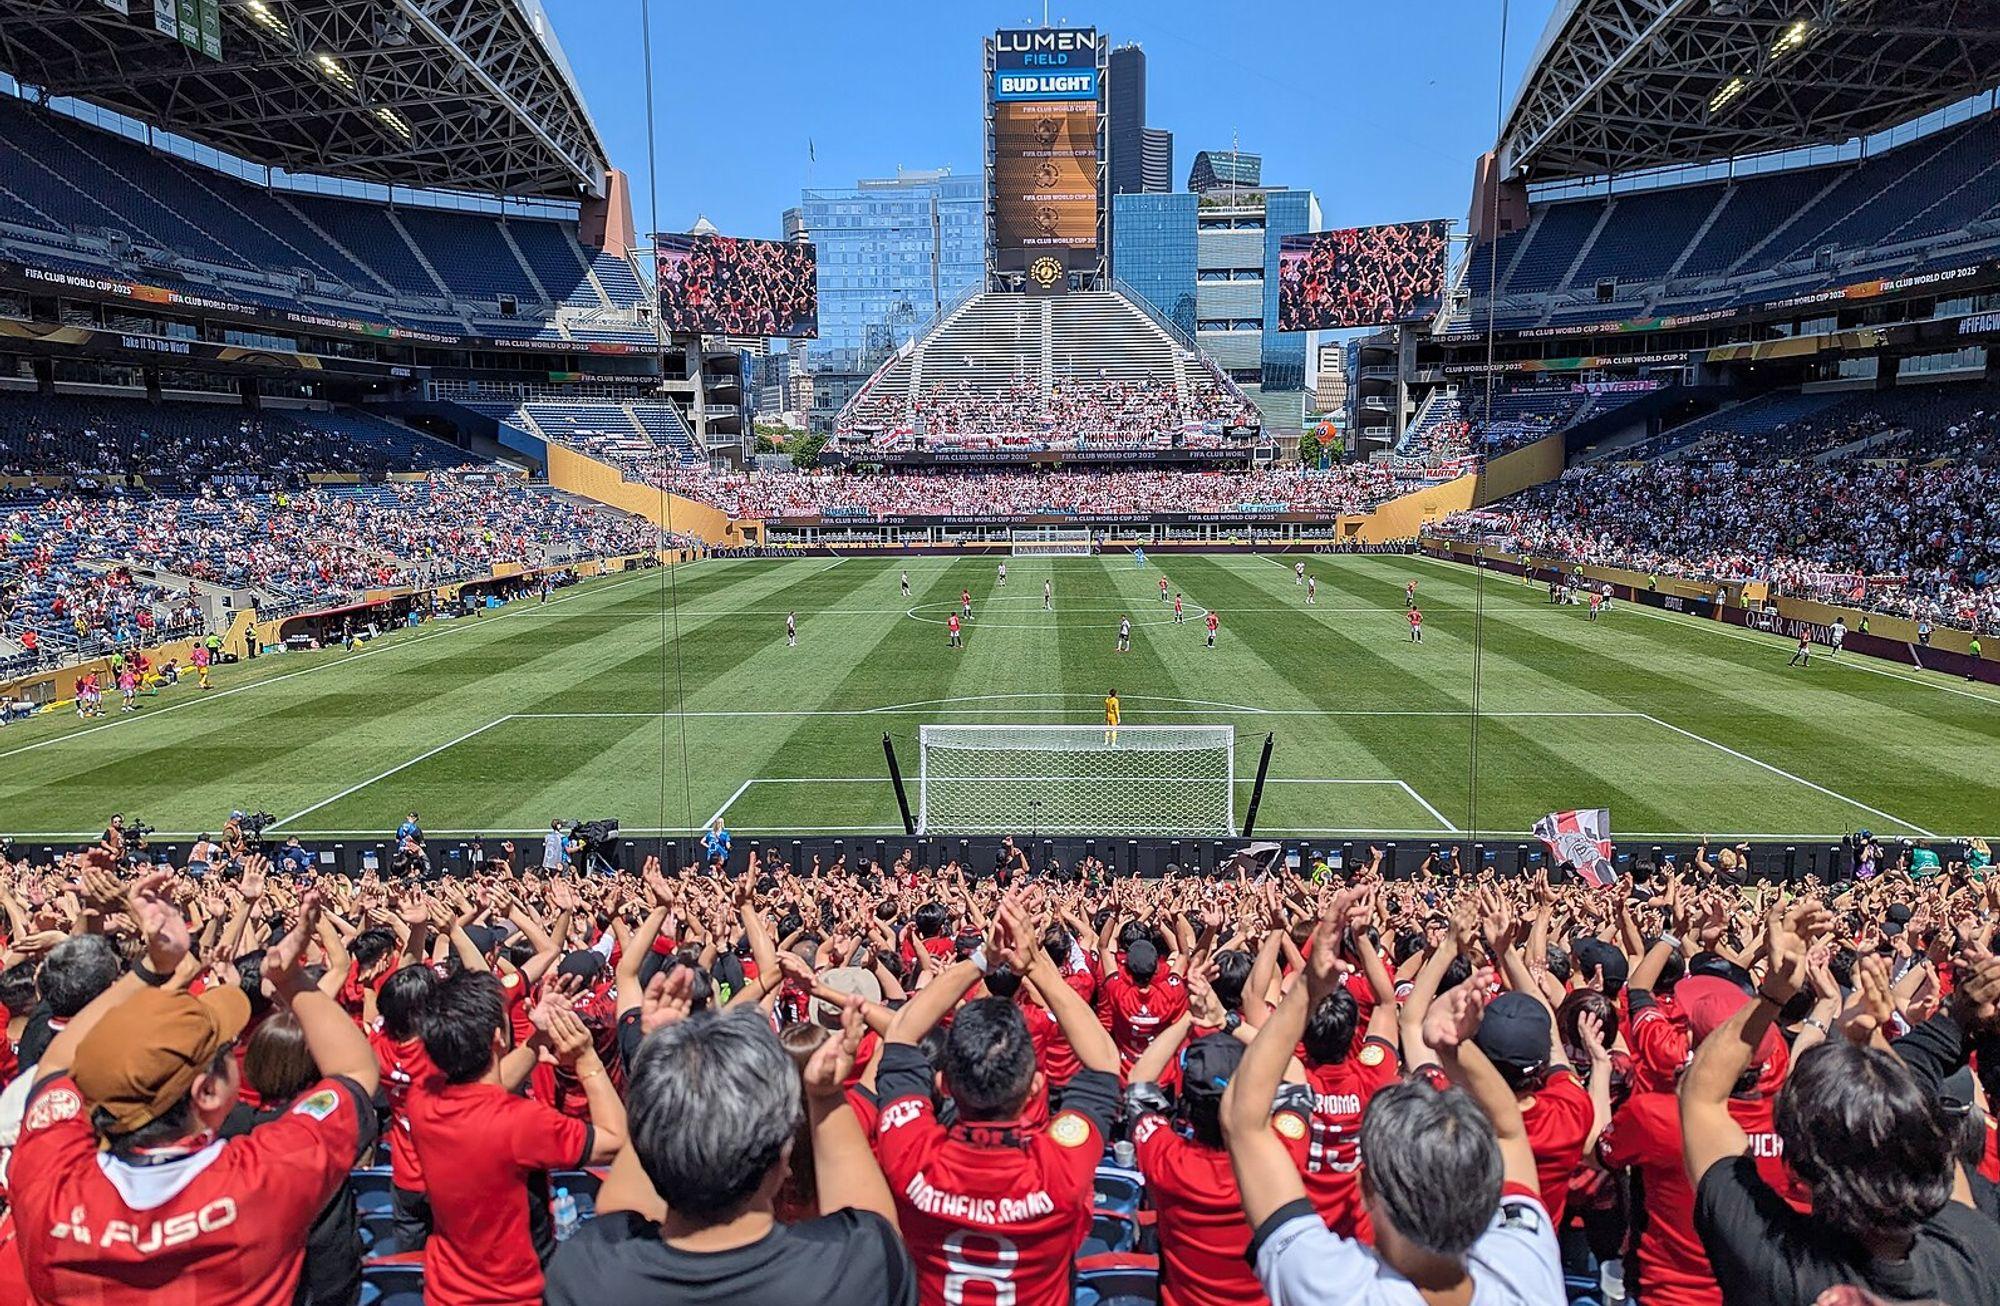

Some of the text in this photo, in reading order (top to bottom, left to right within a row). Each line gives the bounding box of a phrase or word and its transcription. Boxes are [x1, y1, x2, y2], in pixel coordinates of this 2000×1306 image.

[996, 32, 1095, 52] LUMEN
[1025, 53, 1067, 65] FIELD
[1002, 76, 1091, 92] BUD LIGHT
[25, 268, 43, 280] FIFA
[44, 270, 66, 284] CLUB
[66, 275, 95, 289] WORLD
[96, 280, 112, 292] CUP
[1880, 281, 1895, 292] FIFA
[1895, 277, 1913, 289] CLUB
[1914, 273, 1940, 286] WORLD
[1940, 270, 1956, 281] CUP
[168, 293, 183, 303] FIFA
[184, 296, 202, 307] CLUB
[203, 299, 226, 310] WORLD
[227, 302, 239, 312] CUP
[1778, 298, 1793, 308] CLUB
[1794, 294, 1816, 306] WORLD
[1816, 292, 1829, 302] CUP
[287, 312, 301, 322] FIFA
[302, 314, 316, 324] CLUB
[316, 317, 336, 328] WORLD
[337, 319, 347, 329] CUP
[1660, 319, 1676, 328] FIFA
[1677, 317, 1690, 326] CLUB
[1691, 314, 1709, 324] WORLD
[1710, 312, 1721, 321] CUP
[400, 329, 413, 339] CLUB
[413, 331, 431, 341] WORLD
[431, 333, 440, 342] CUP
[1519, 330, 1535, 338] FIFA
[1535, 328, 1554, 337] CLUB
[1555, 326, 1582, 336] WORLD
[1583, 325, 1599, 334] CUP
[495, 339, 511, 347] FIFA
[511, 340, 530, 348] CLUB
[531, 341, 556, 349] WORLD
[557, 342, 571, 350] CUP
[625, 345, 638, 353] FIFA
[639, 346, 658, 354] CLUB
[1596, 353, 1678, 366] FIFA CLUB WORLD CUP
[1463, 365, 1488, 373] WORLD
[1505, 363, 1523, 371] 2025
[597, 375, 615, 383] CLUB
[640, 376, 653, 384] CUP
[718, 549, 807, 558] QATAR AIRWAYS
[1313, 544, 1405, 554] QATAR AIRWAYS
[1746, 611, 1832, 644] QATAR AIRWAY
[100, 1197, 238, 1252] FUSO
